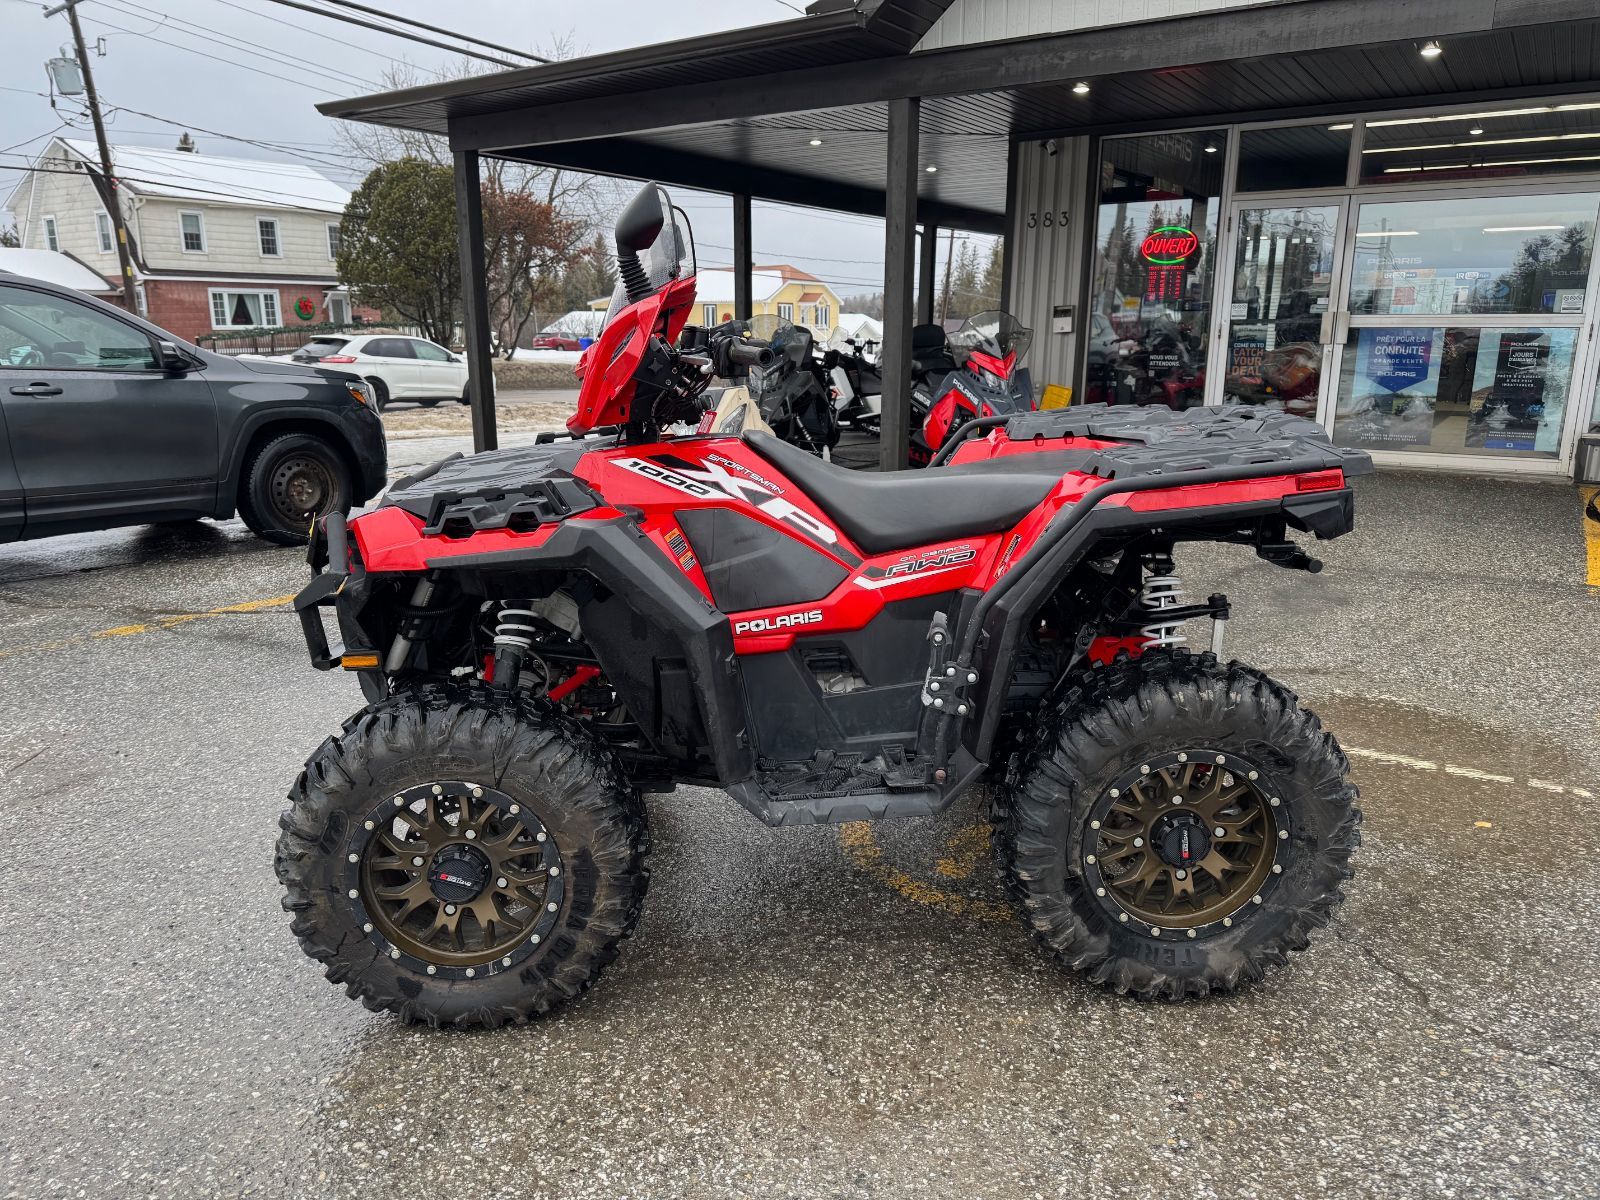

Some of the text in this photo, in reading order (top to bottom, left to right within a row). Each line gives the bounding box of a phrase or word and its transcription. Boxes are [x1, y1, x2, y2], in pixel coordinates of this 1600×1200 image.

[1027, 211, 1069, 229] 383
[1144, 238, 1194, 254] OUVERT
[1416, 335, 1426, 343] LA
[1233, 348, 1264, 357] CATCH
[1374, 345, 1425, 356] CONDUITE
[1233, 356, 1262, 366] YOUR
[1231, 365, 1262, 376] DEAL
[952, 378, 980, 406] POLARIS
[628, 461, 712, 496] 1000
[706, 453, 786, 495] SPORTSMAN
[668, 456, 839, 545] XP
[885, 549, 977, 577] AWD
[734, 609, 823, 635] POLARIS
